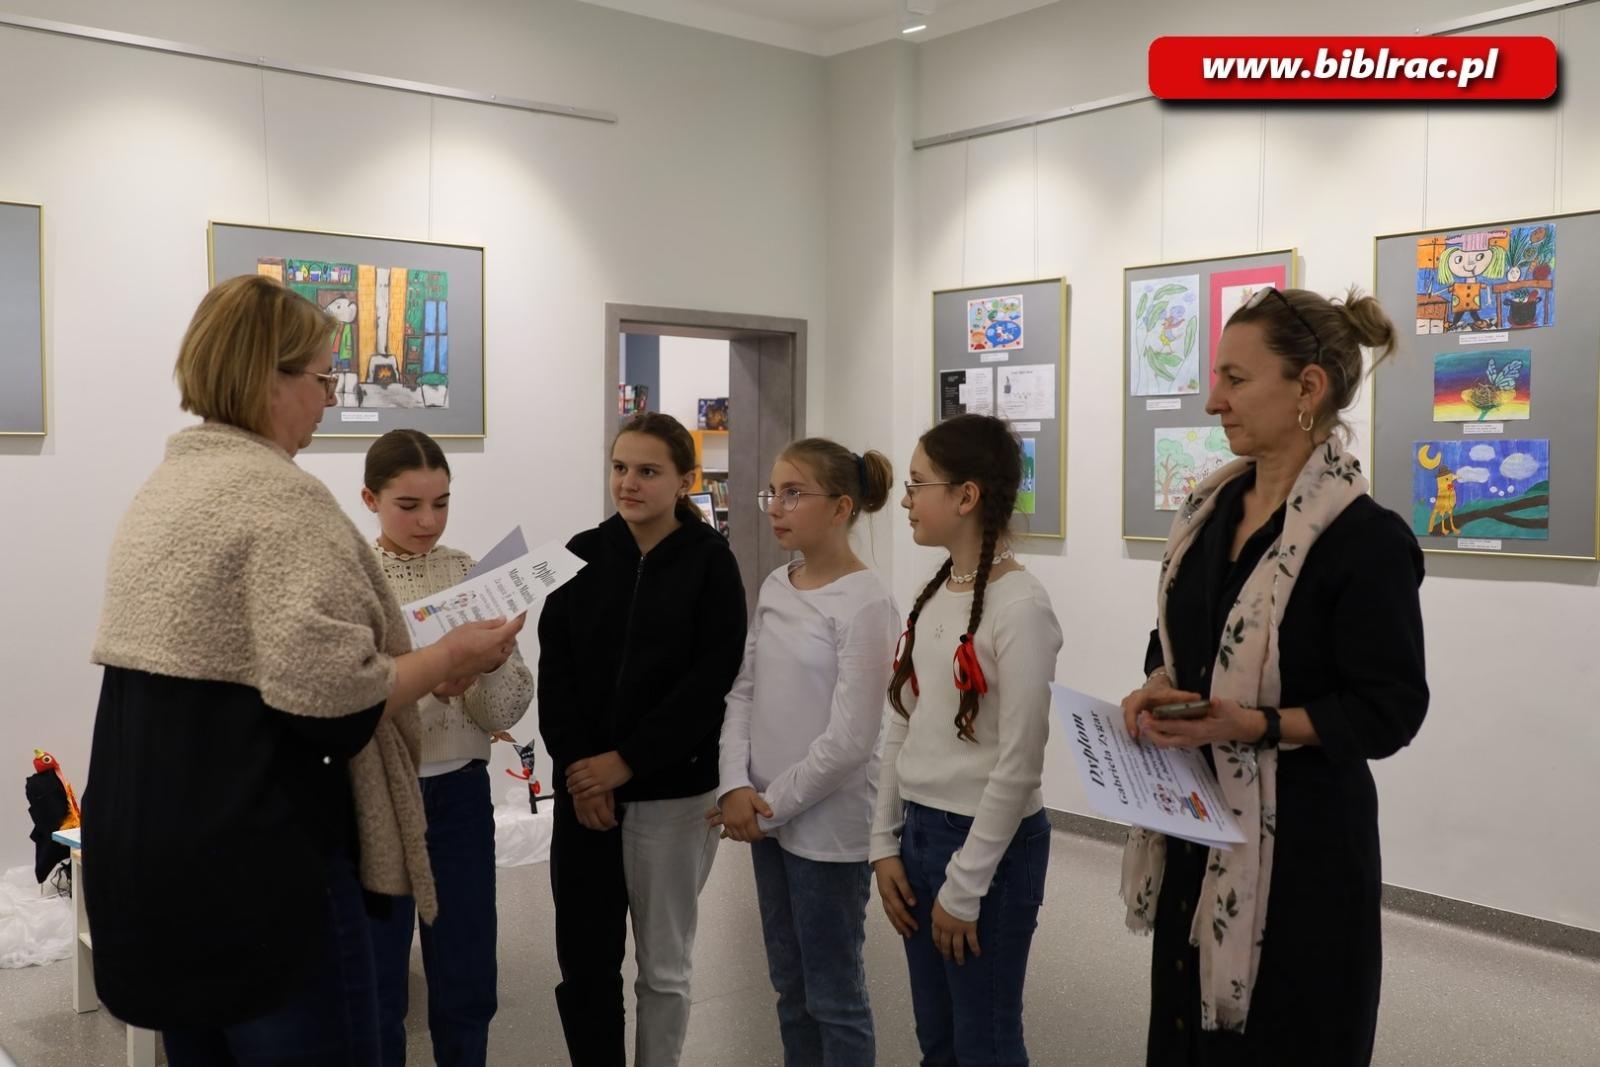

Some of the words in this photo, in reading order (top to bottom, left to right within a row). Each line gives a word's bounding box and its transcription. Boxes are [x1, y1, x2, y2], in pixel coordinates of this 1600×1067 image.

[532, 561, 557, 587] Dyplo
[1072, 713, 1105, 788] Dyplom
[1103, 751, 1129, 805] Gabriela
